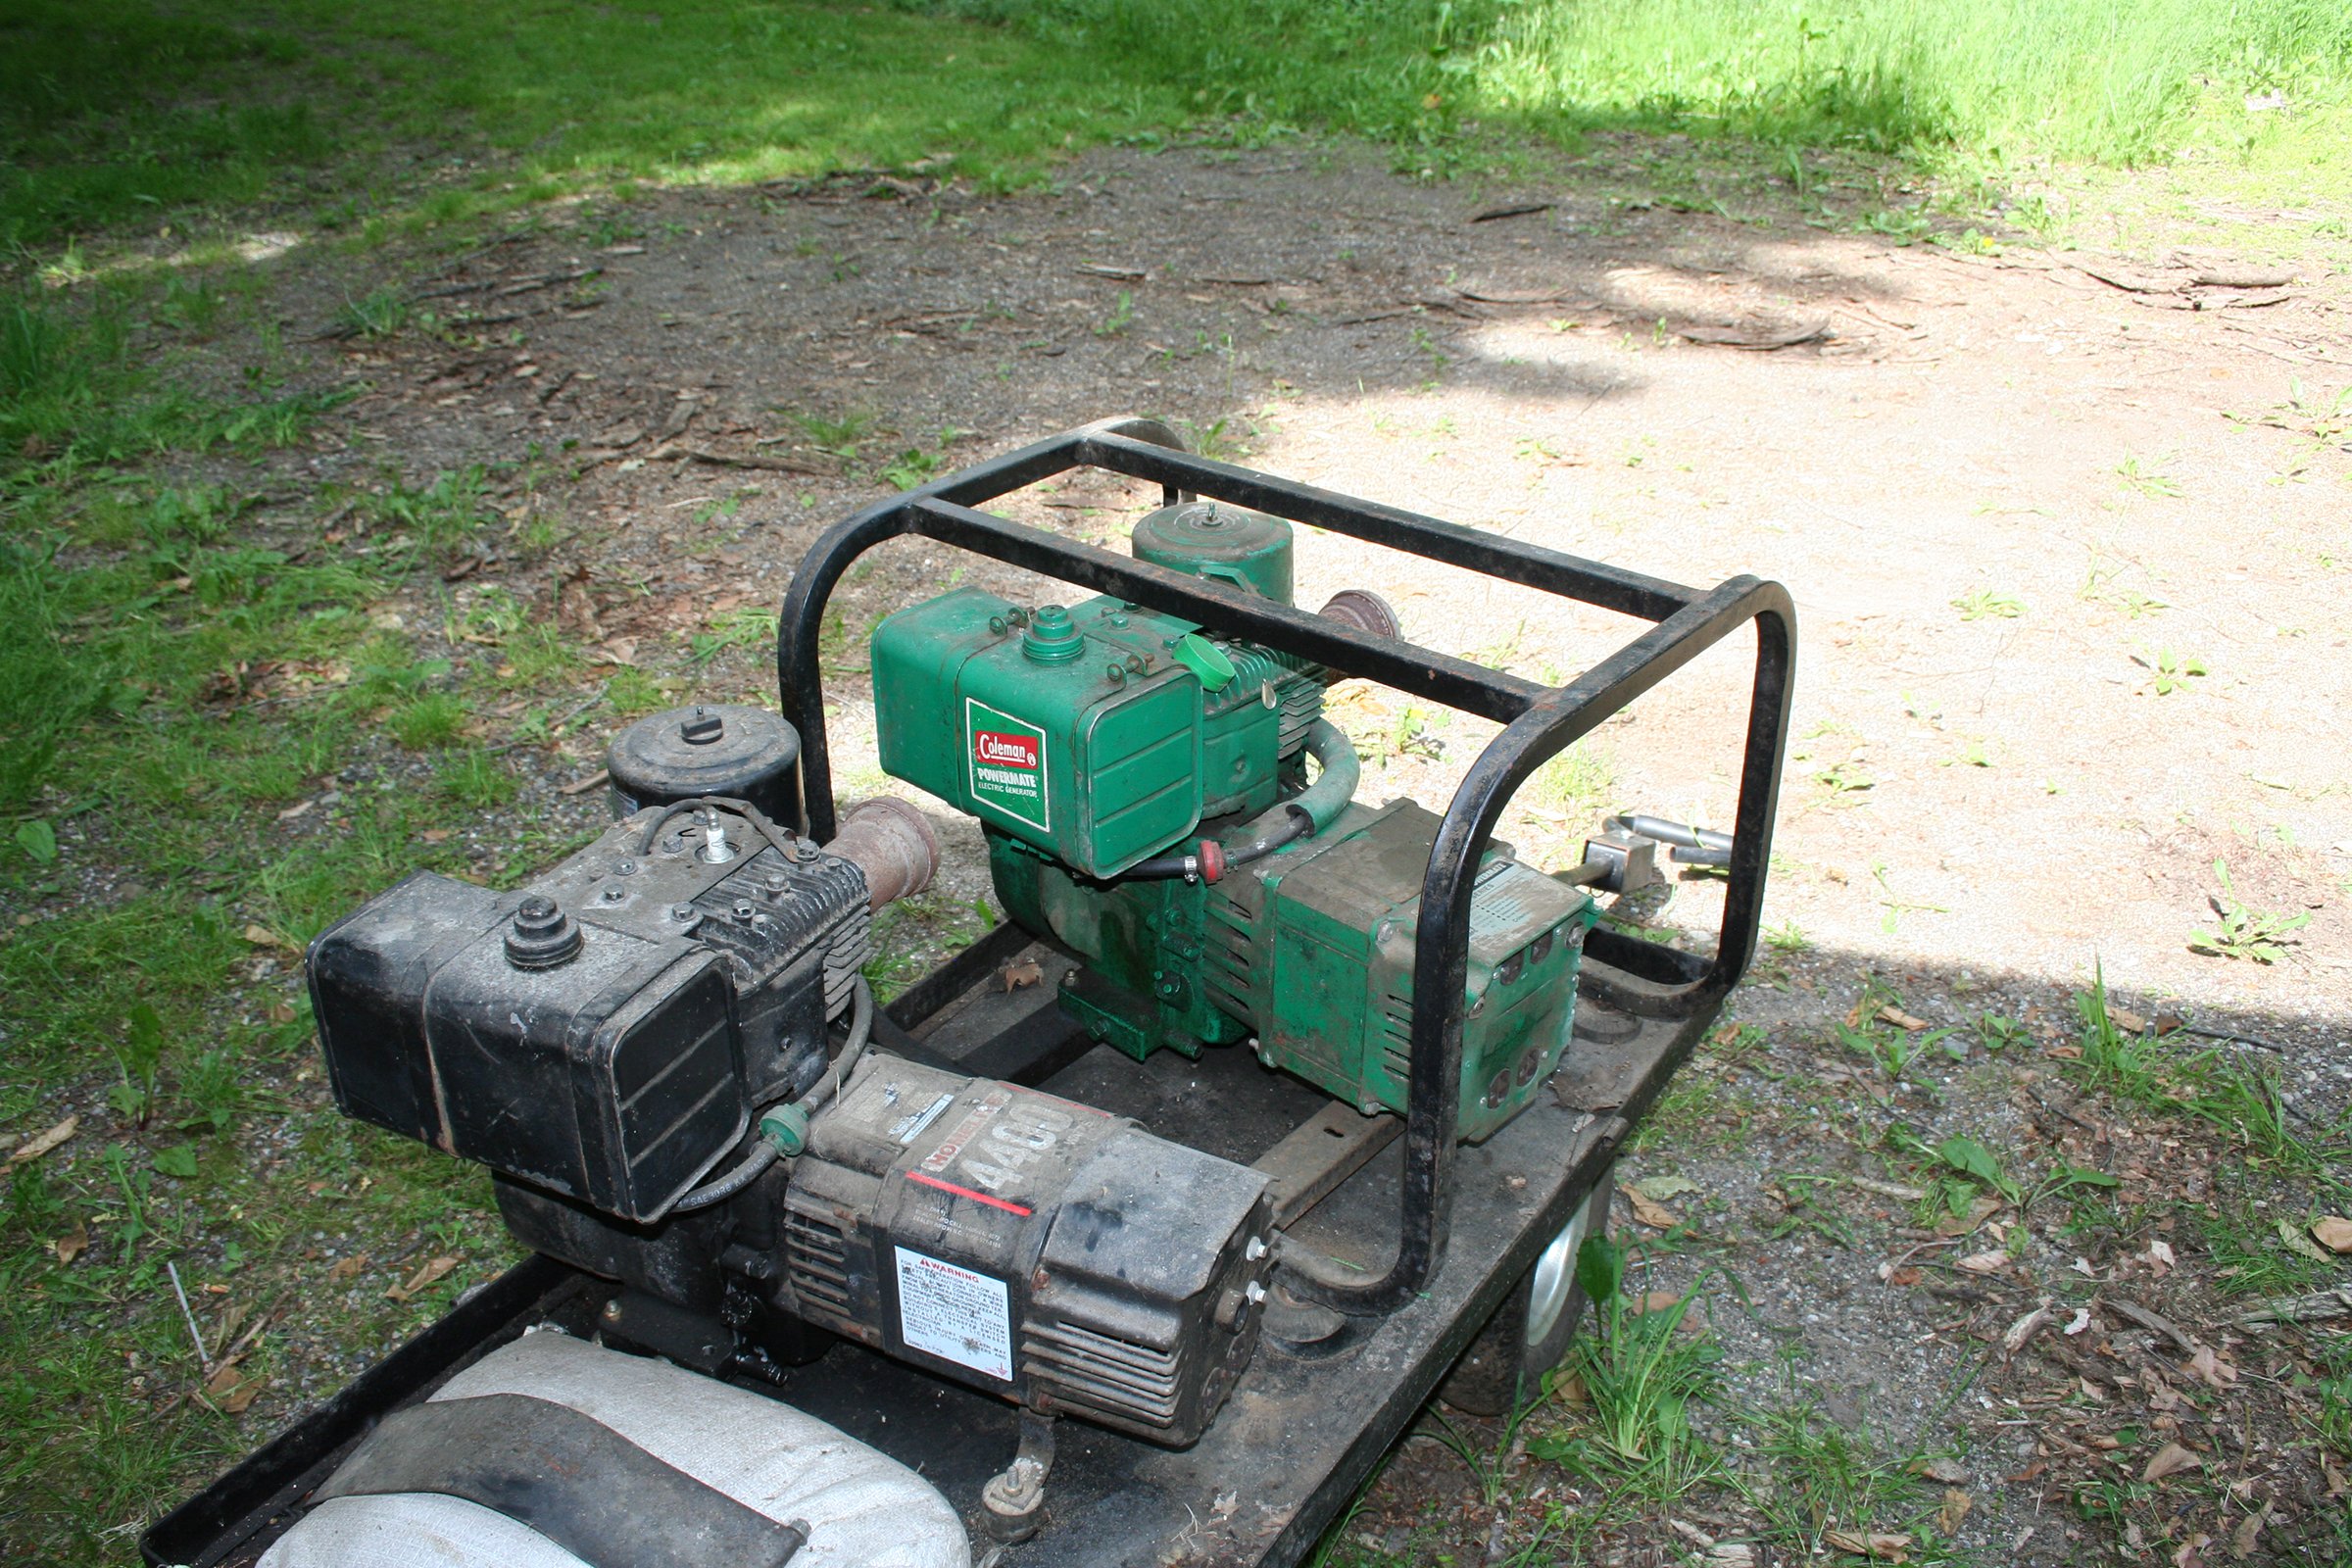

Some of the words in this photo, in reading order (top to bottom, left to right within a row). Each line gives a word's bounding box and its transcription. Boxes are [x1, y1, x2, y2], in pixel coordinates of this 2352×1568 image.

[980, 734, 1025, 760] Coleman
[977, 768, 1037, 787] POWERMATE
[978, 782, 1004, 793] ELECTRIC
[1005, 785, 1037, 798] GENERATOR
[960, 1103, 1073, 1190] 4400
[901, 1265, 923, 1277] SETY
[931, 1261, 979, 1284] WARNING
